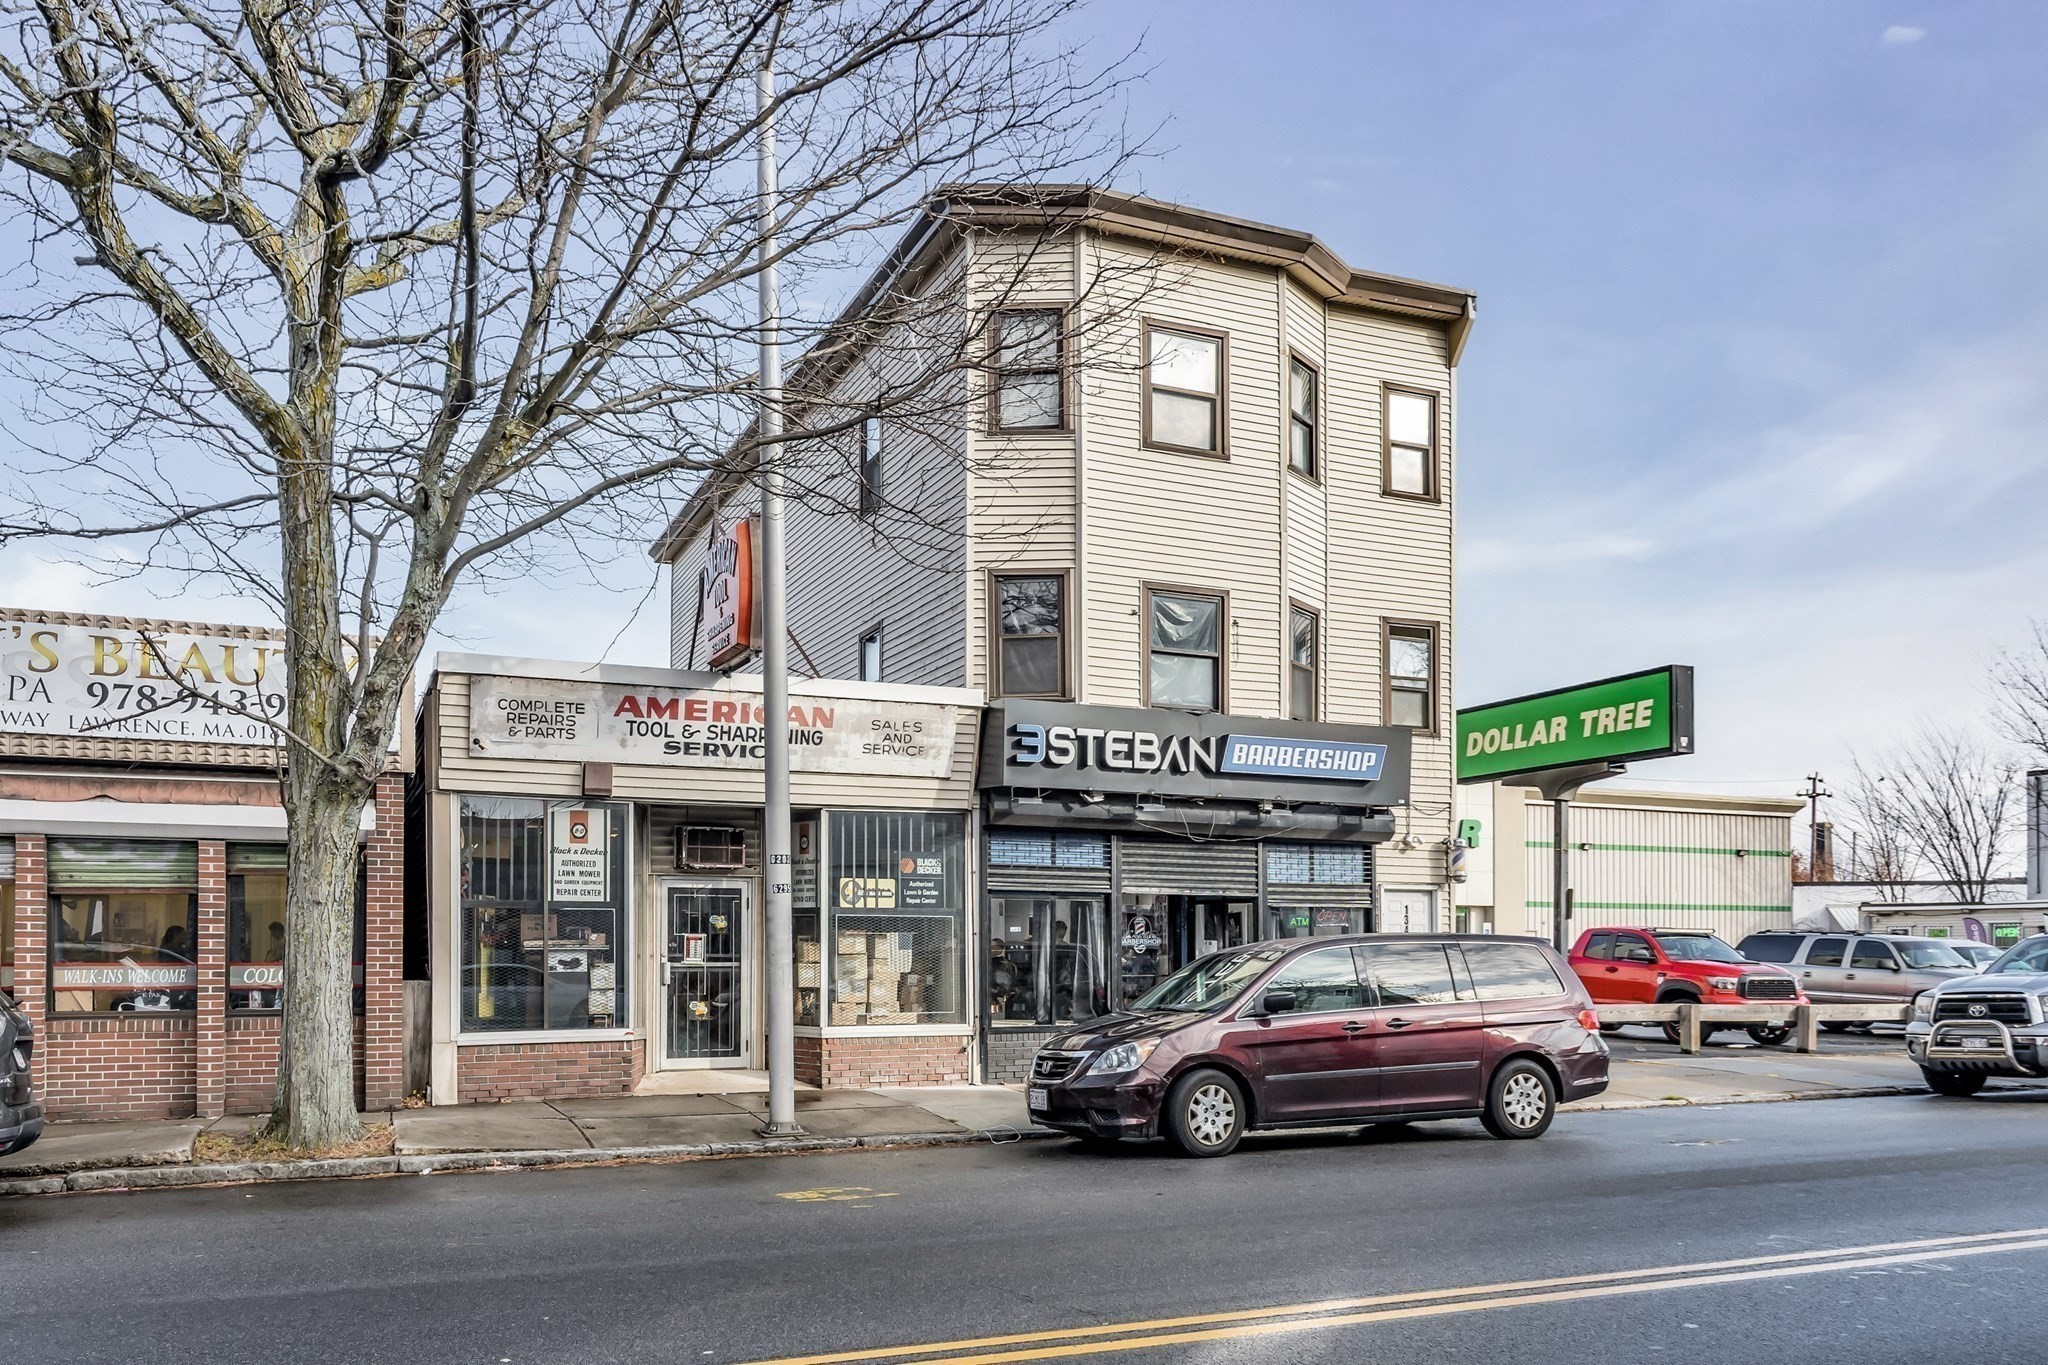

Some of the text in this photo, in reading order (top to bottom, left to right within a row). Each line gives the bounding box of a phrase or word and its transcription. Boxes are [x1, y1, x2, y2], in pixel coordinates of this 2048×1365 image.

[497, 698, 586, 715] COMPLETE
[506, 711, 577, 727] REPAIRS
[871, 719, 923, 733] SALES
[508, 726, 576, 740] & PARTS
[626, 719, 824, 746] TOOL & SHARPING
[1465, 698, 1654, 757] DOLLAR TREE
[882, 733, 913, 744] AND
[663, 740, 766, 759] SERVIC
[862, 743, 925, 757] SERVICE
[1231, 743, 1377, 772] BARBERSHOP
[560, 860, 597, 868] AUTHORIZED
[557, 869, 601, 878] LAWN MOWER
[556, 888, 602, 897] REPAIR CENTER
[1290, 917, 1309, 926] ATM
[1317, 910, 1347, 923] OPEN
[63, 968, 187, 984] WALK-INS WELCOME
